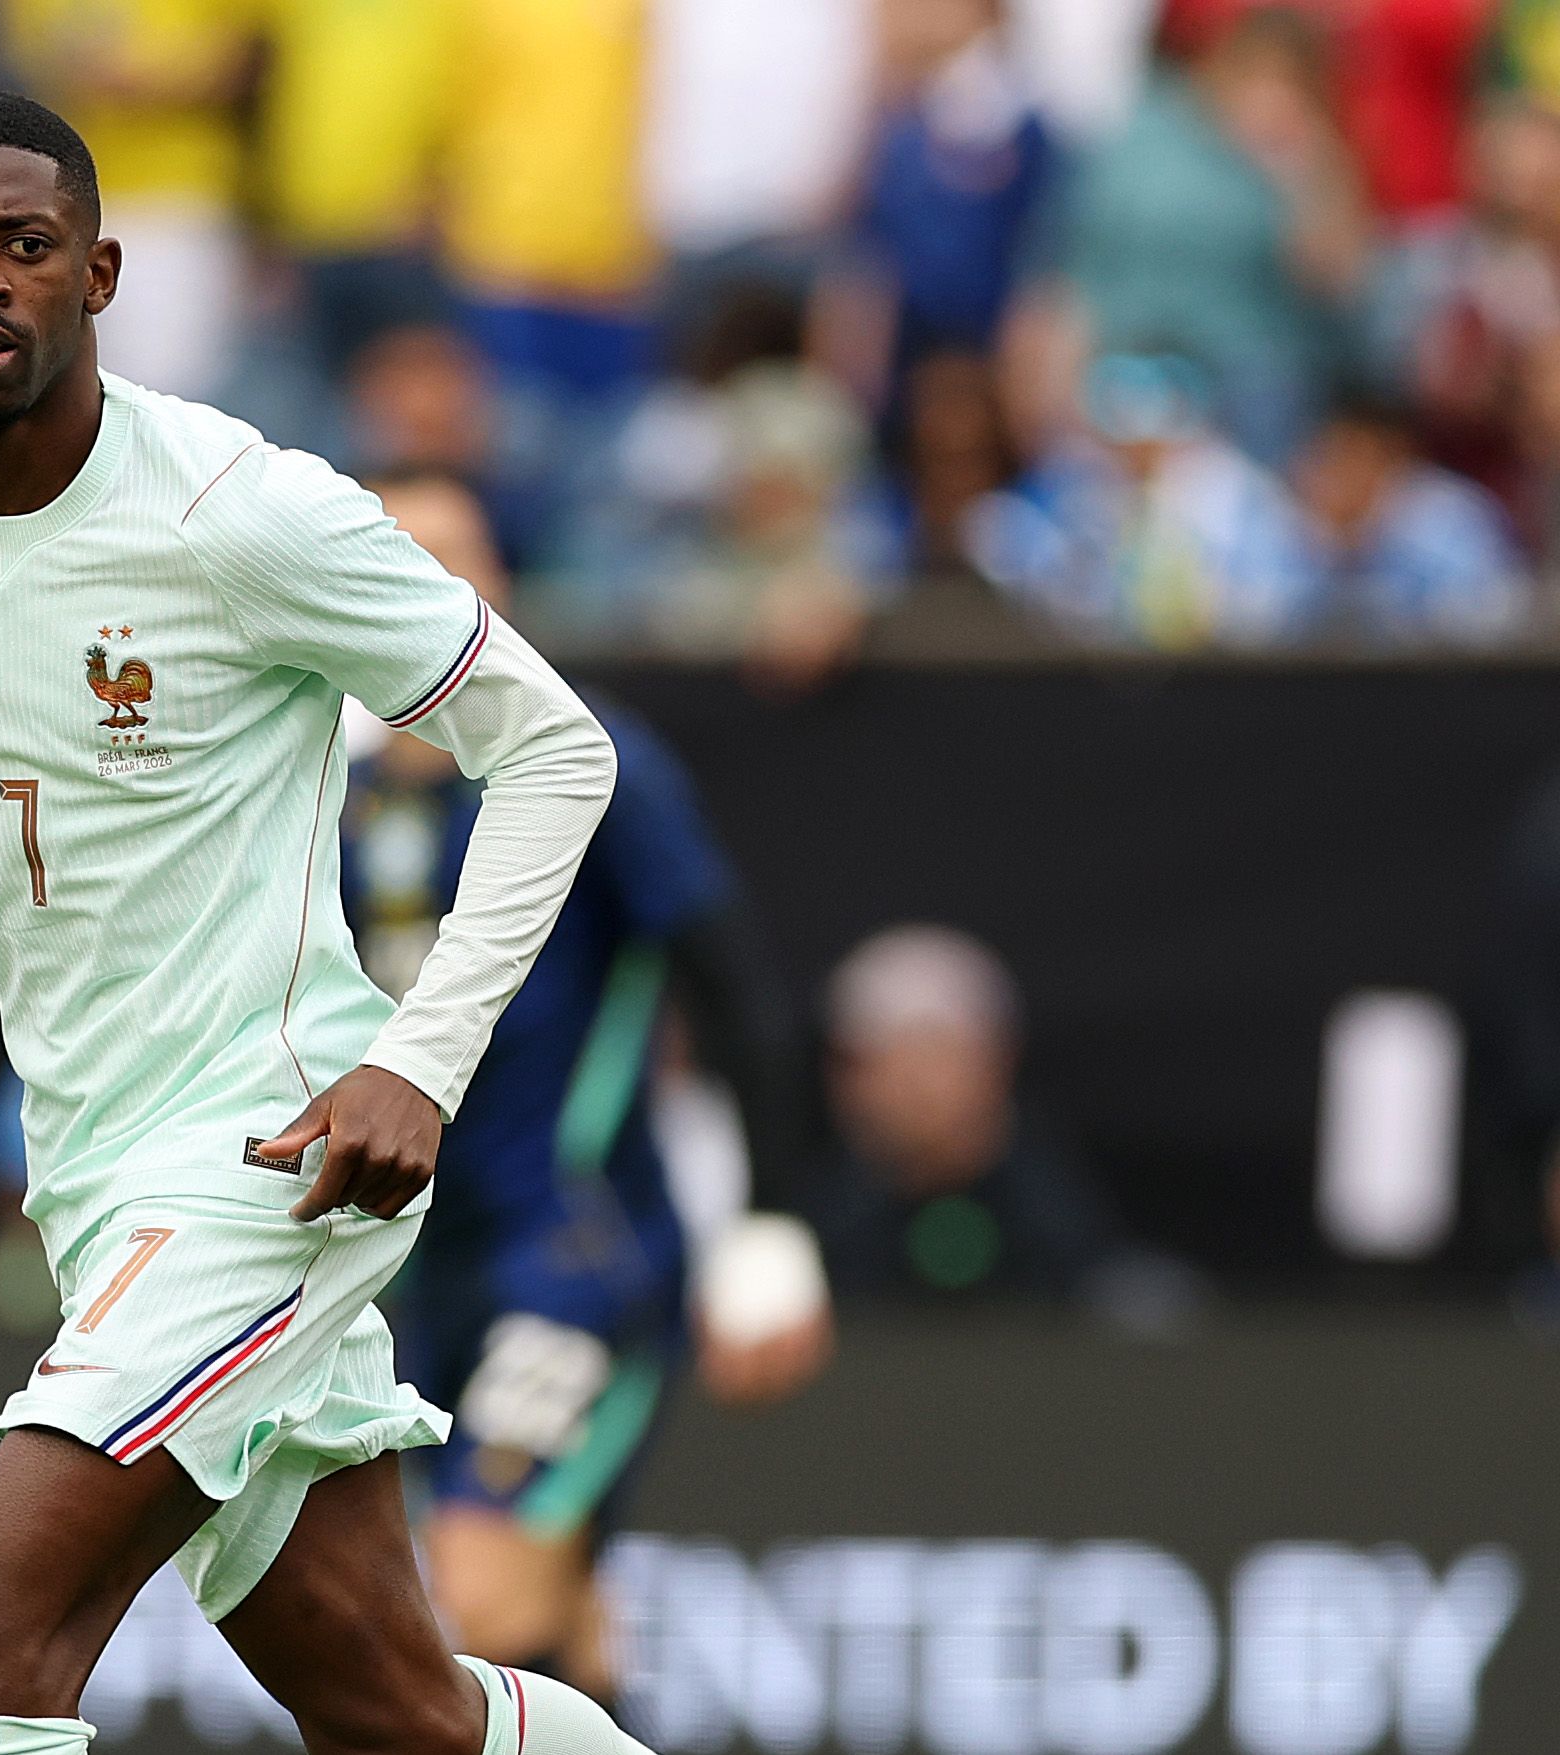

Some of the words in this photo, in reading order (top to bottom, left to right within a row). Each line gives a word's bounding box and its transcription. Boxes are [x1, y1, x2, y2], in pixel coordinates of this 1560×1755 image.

[97, 749, 126, 764] BRÉSIL
[134, 746, 169, 759] FRANCE
[98, 764, 113, 777] 26
[115, 759, 140, 774] MARS
[143, 754, 173, 770] 2026
[74, 1227, 177, 1335] 7
